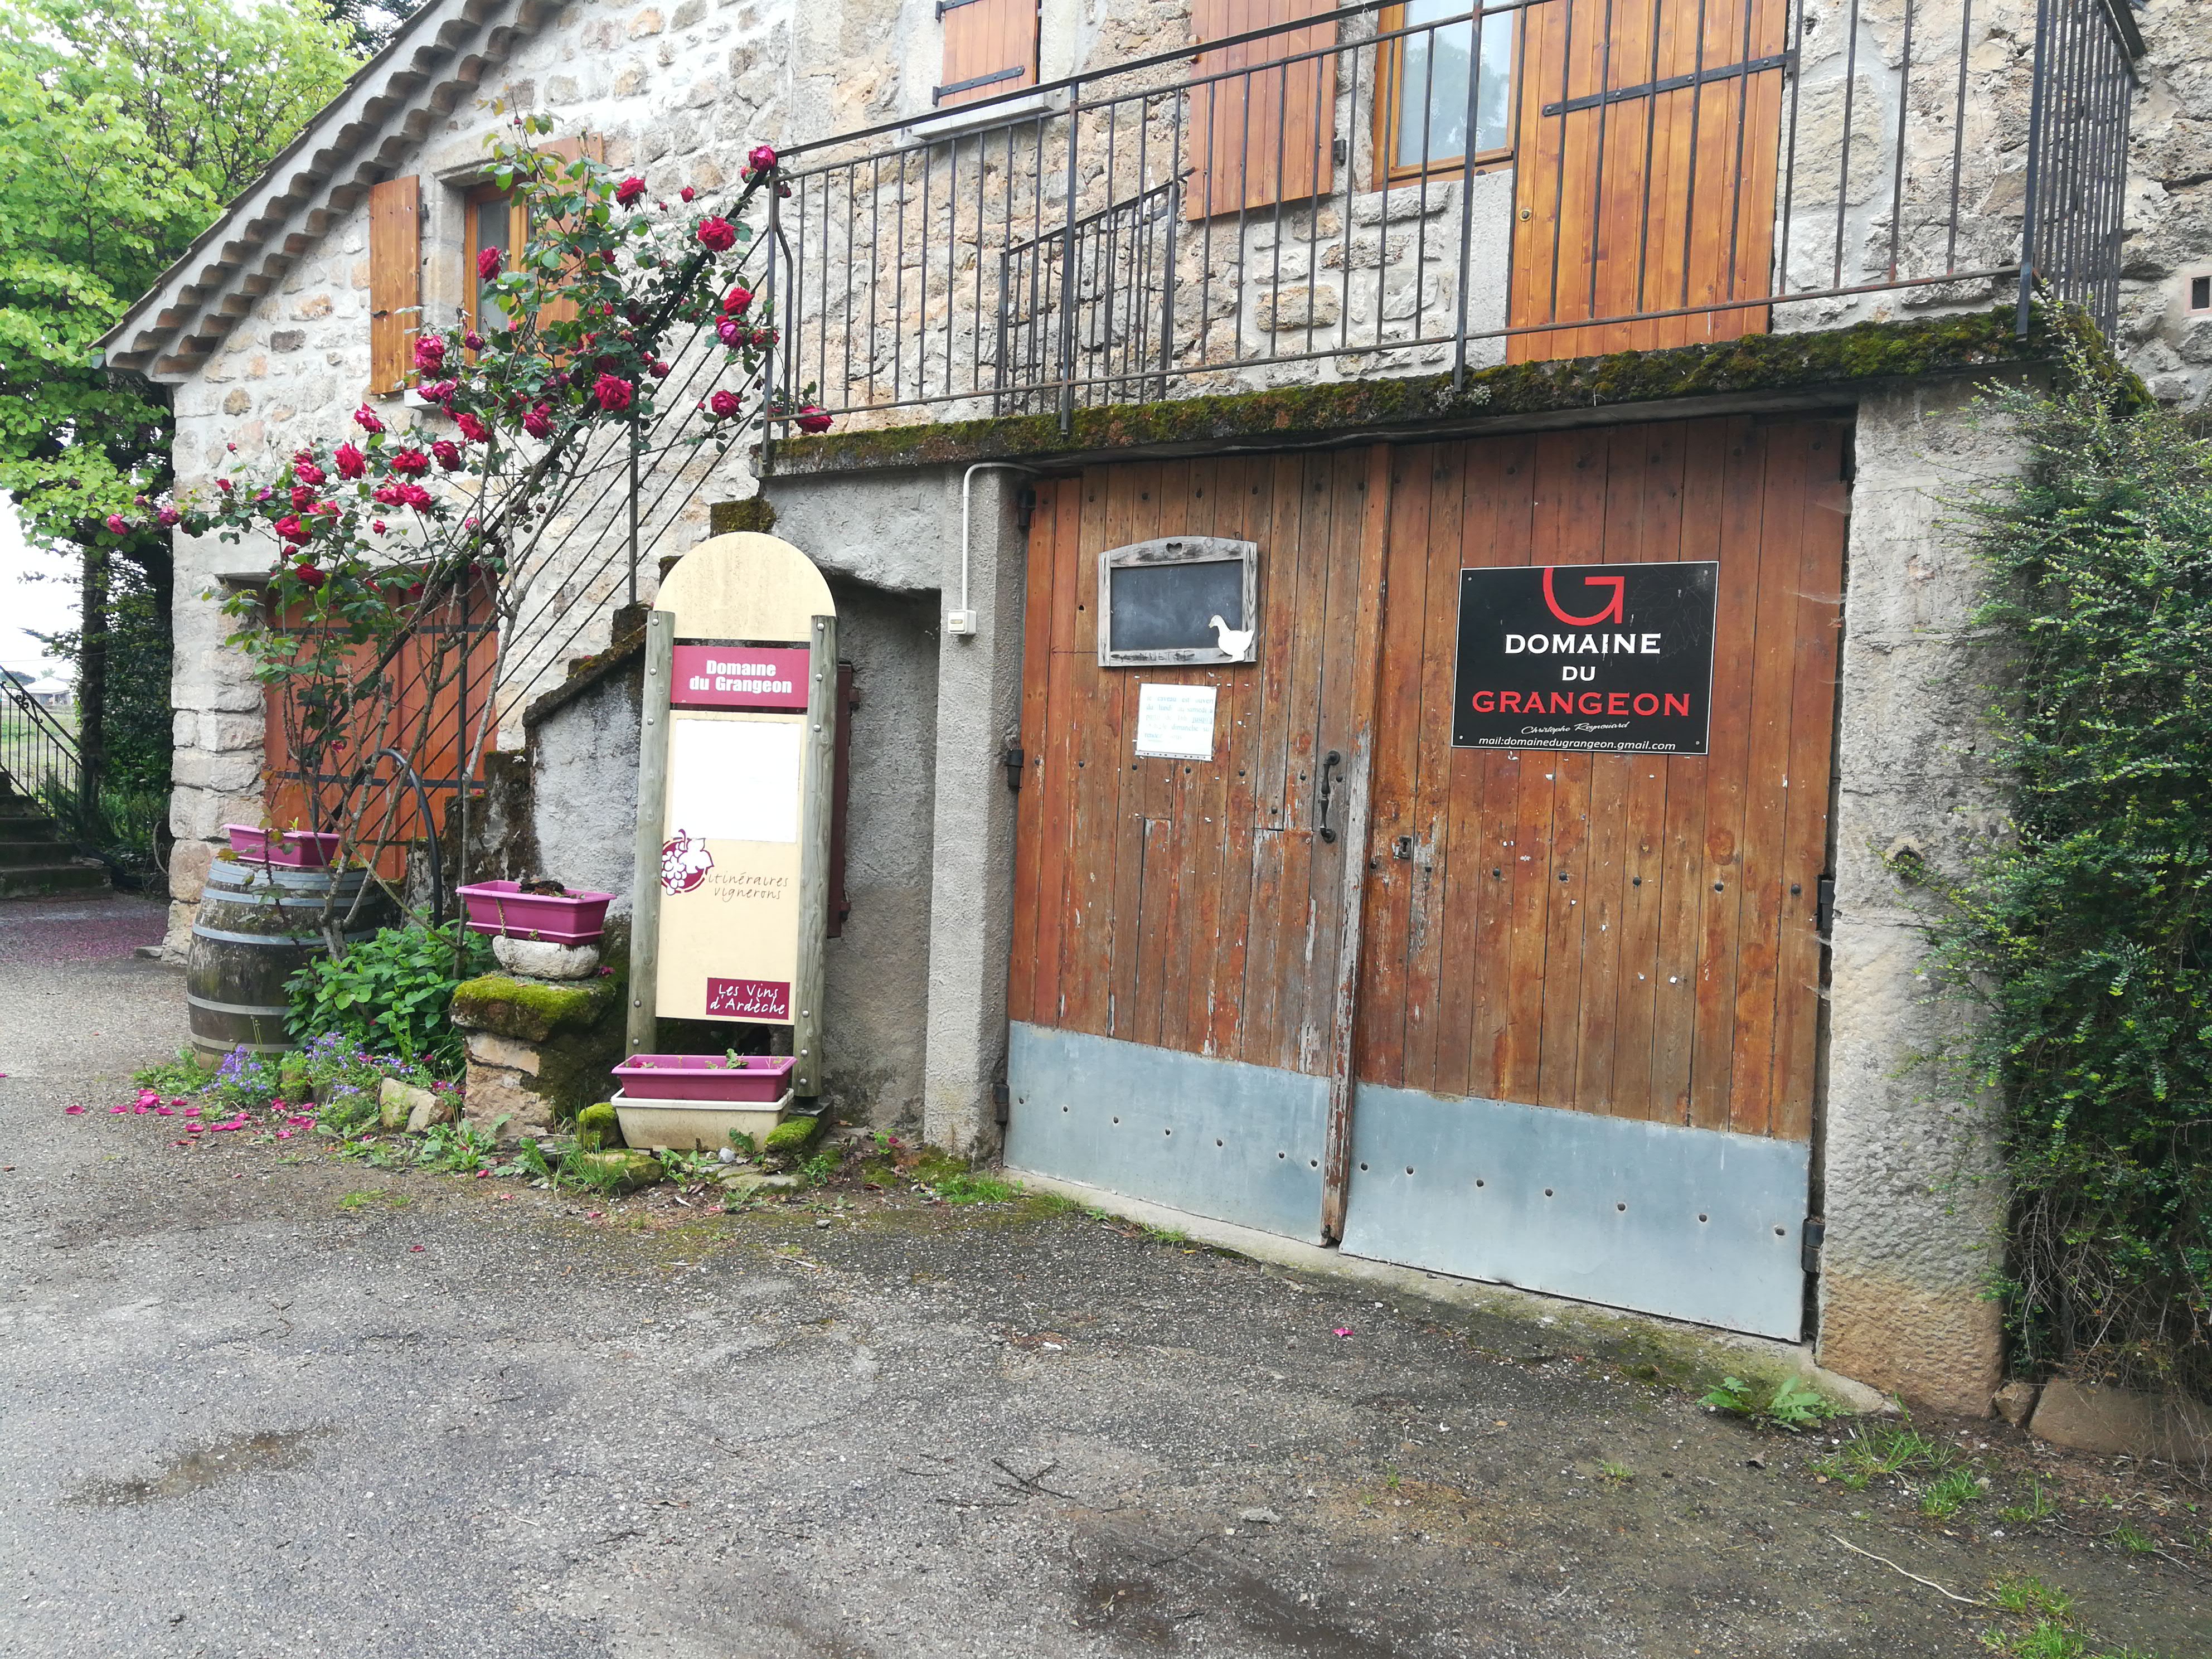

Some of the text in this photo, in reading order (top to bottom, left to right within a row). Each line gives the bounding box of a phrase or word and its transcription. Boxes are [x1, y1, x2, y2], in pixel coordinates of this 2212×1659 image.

[1505, 633, 1661, 654] DOMAINE
[706, 659, 776, 676] Domaine
[1562, 666, 1596, 681] DU
[690, 676, 792, 693] du Grangeon
[1472, 691, 1690, 716] GRANGEON
[1521, 726, 1570, 735] Christophe
[1478, 737, 1676, 751] mail:domainedugrangeon.gmail.com
[708, 872, 789, 887] itinéraires
[714, 888, 781, 903] vignerons
[719, 983, 778, 1000] Les Vins
[710, 995, 785, 1015] d'Ardèche
